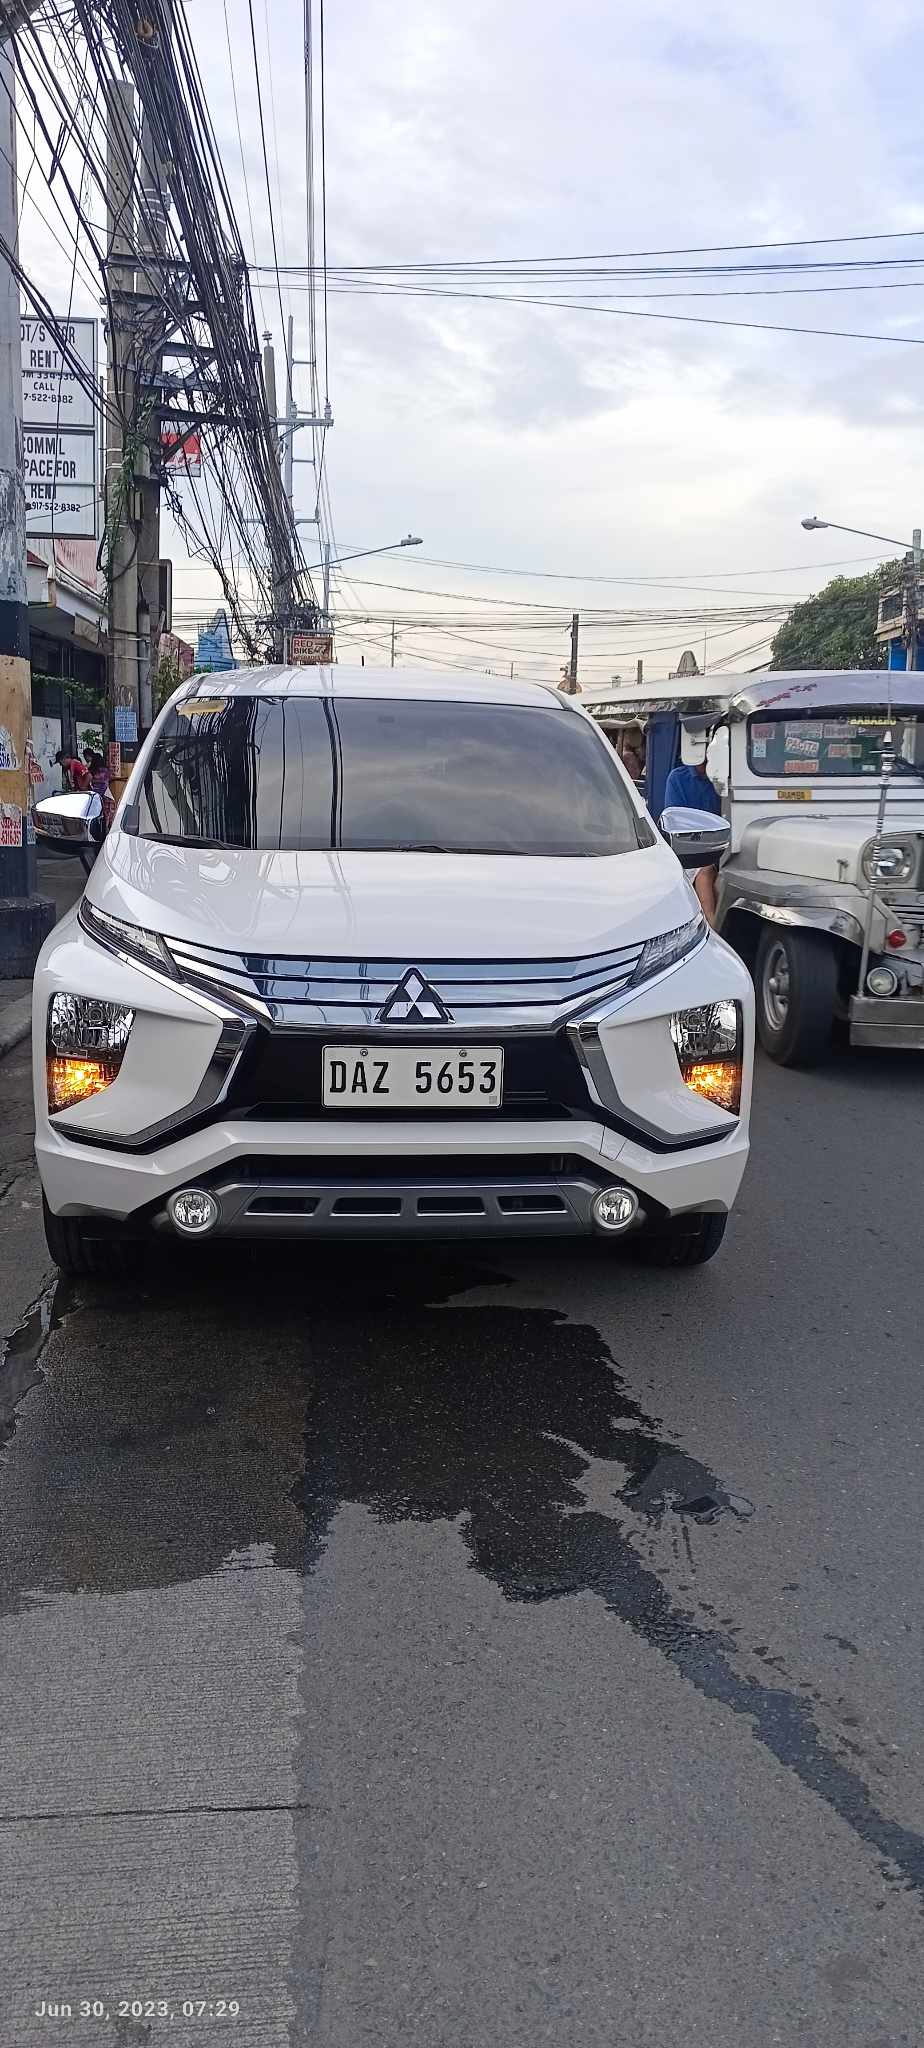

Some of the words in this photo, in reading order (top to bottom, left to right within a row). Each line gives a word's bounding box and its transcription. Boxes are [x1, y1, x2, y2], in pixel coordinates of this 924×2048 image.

[30, 350, 58, 368] RENT
[33, 381, 55, 391] CALL
[55, 460, 76, 479] FOR
[329, 1060, 390, 1093] DAZ
[415, 1061, 497, 1094] 5653
